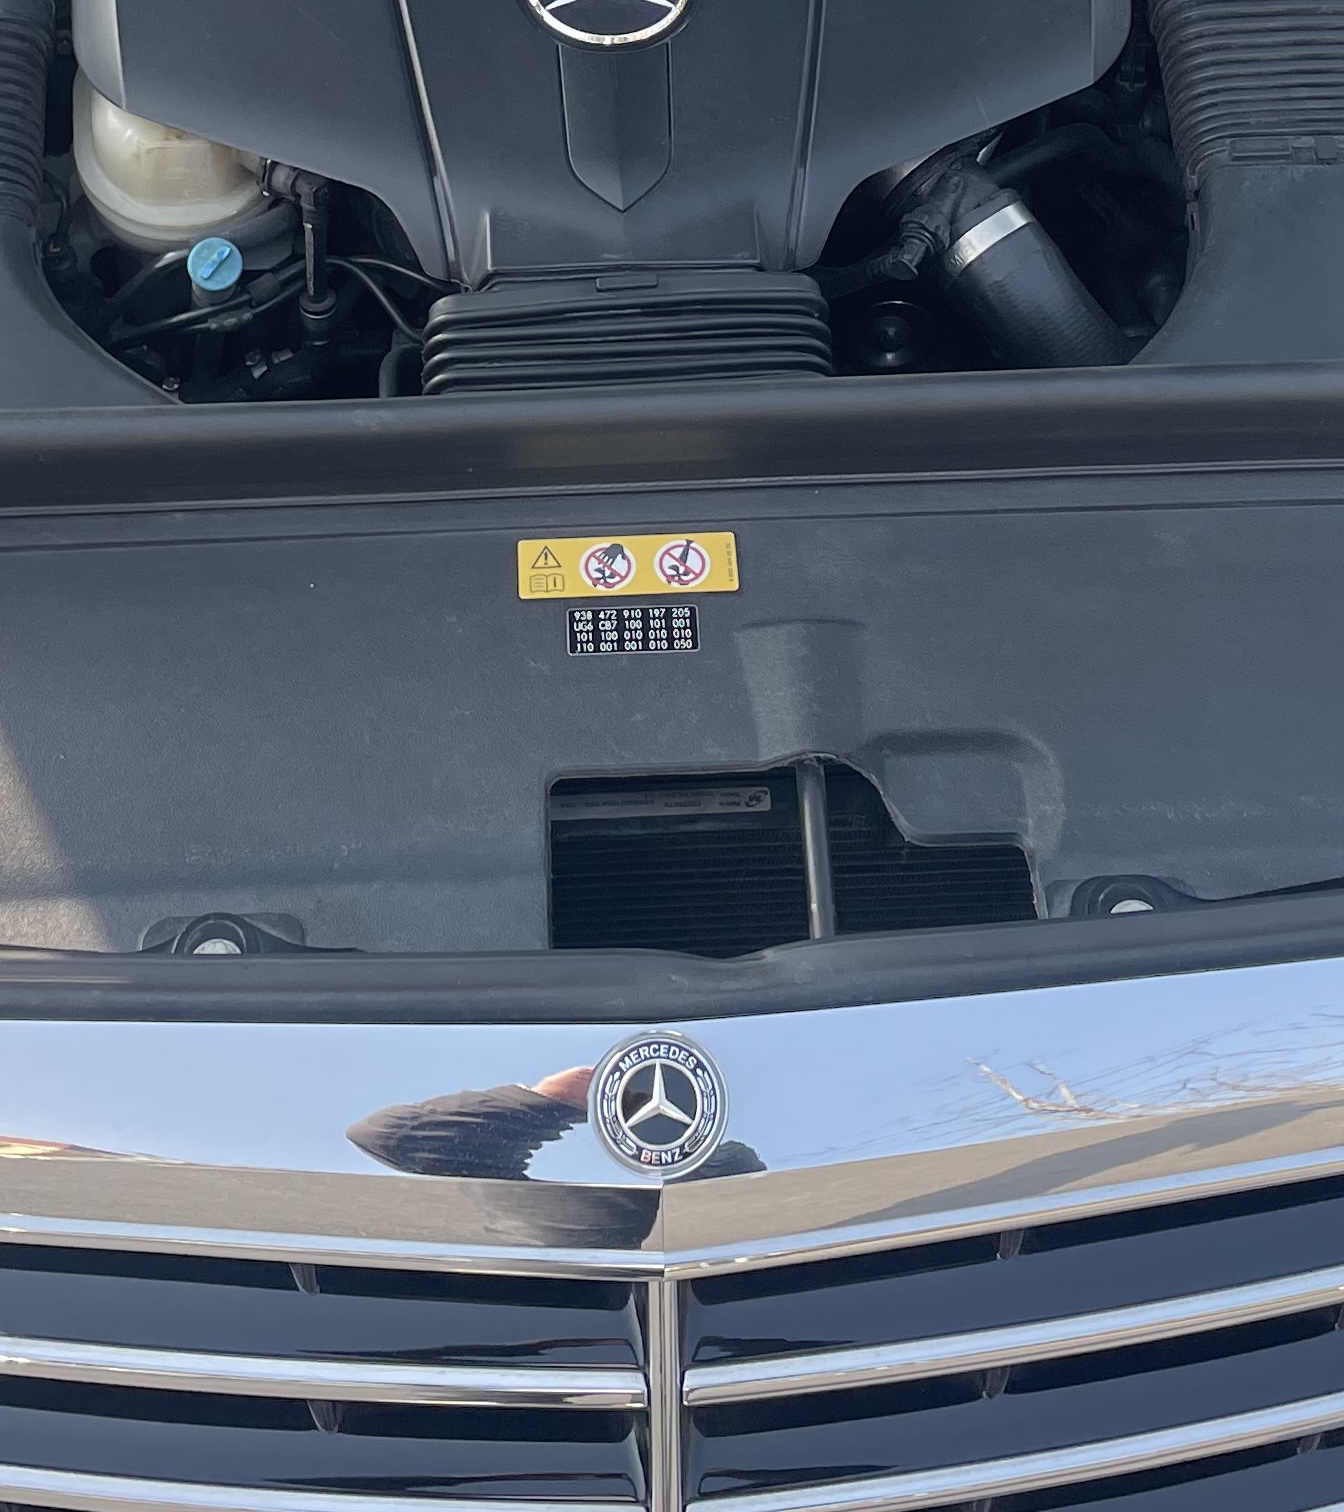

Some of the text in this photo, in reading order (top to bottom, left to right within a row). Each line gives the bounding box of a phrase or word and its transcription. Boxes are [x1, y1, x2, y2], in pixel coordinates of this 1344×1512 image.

[573, 607, 691, 621] 938 472 910 197 205
[573, 618, 691, 631] UG6 CB7 100 101 001
[576, 628, 692, 642] 101 100 010 010 010
[576, 638, 693, 652] 110 001 001 010 050
[618, 1043, 697, 1071] MERCEDES
[640, 1148, 683, 1165] BENZ
